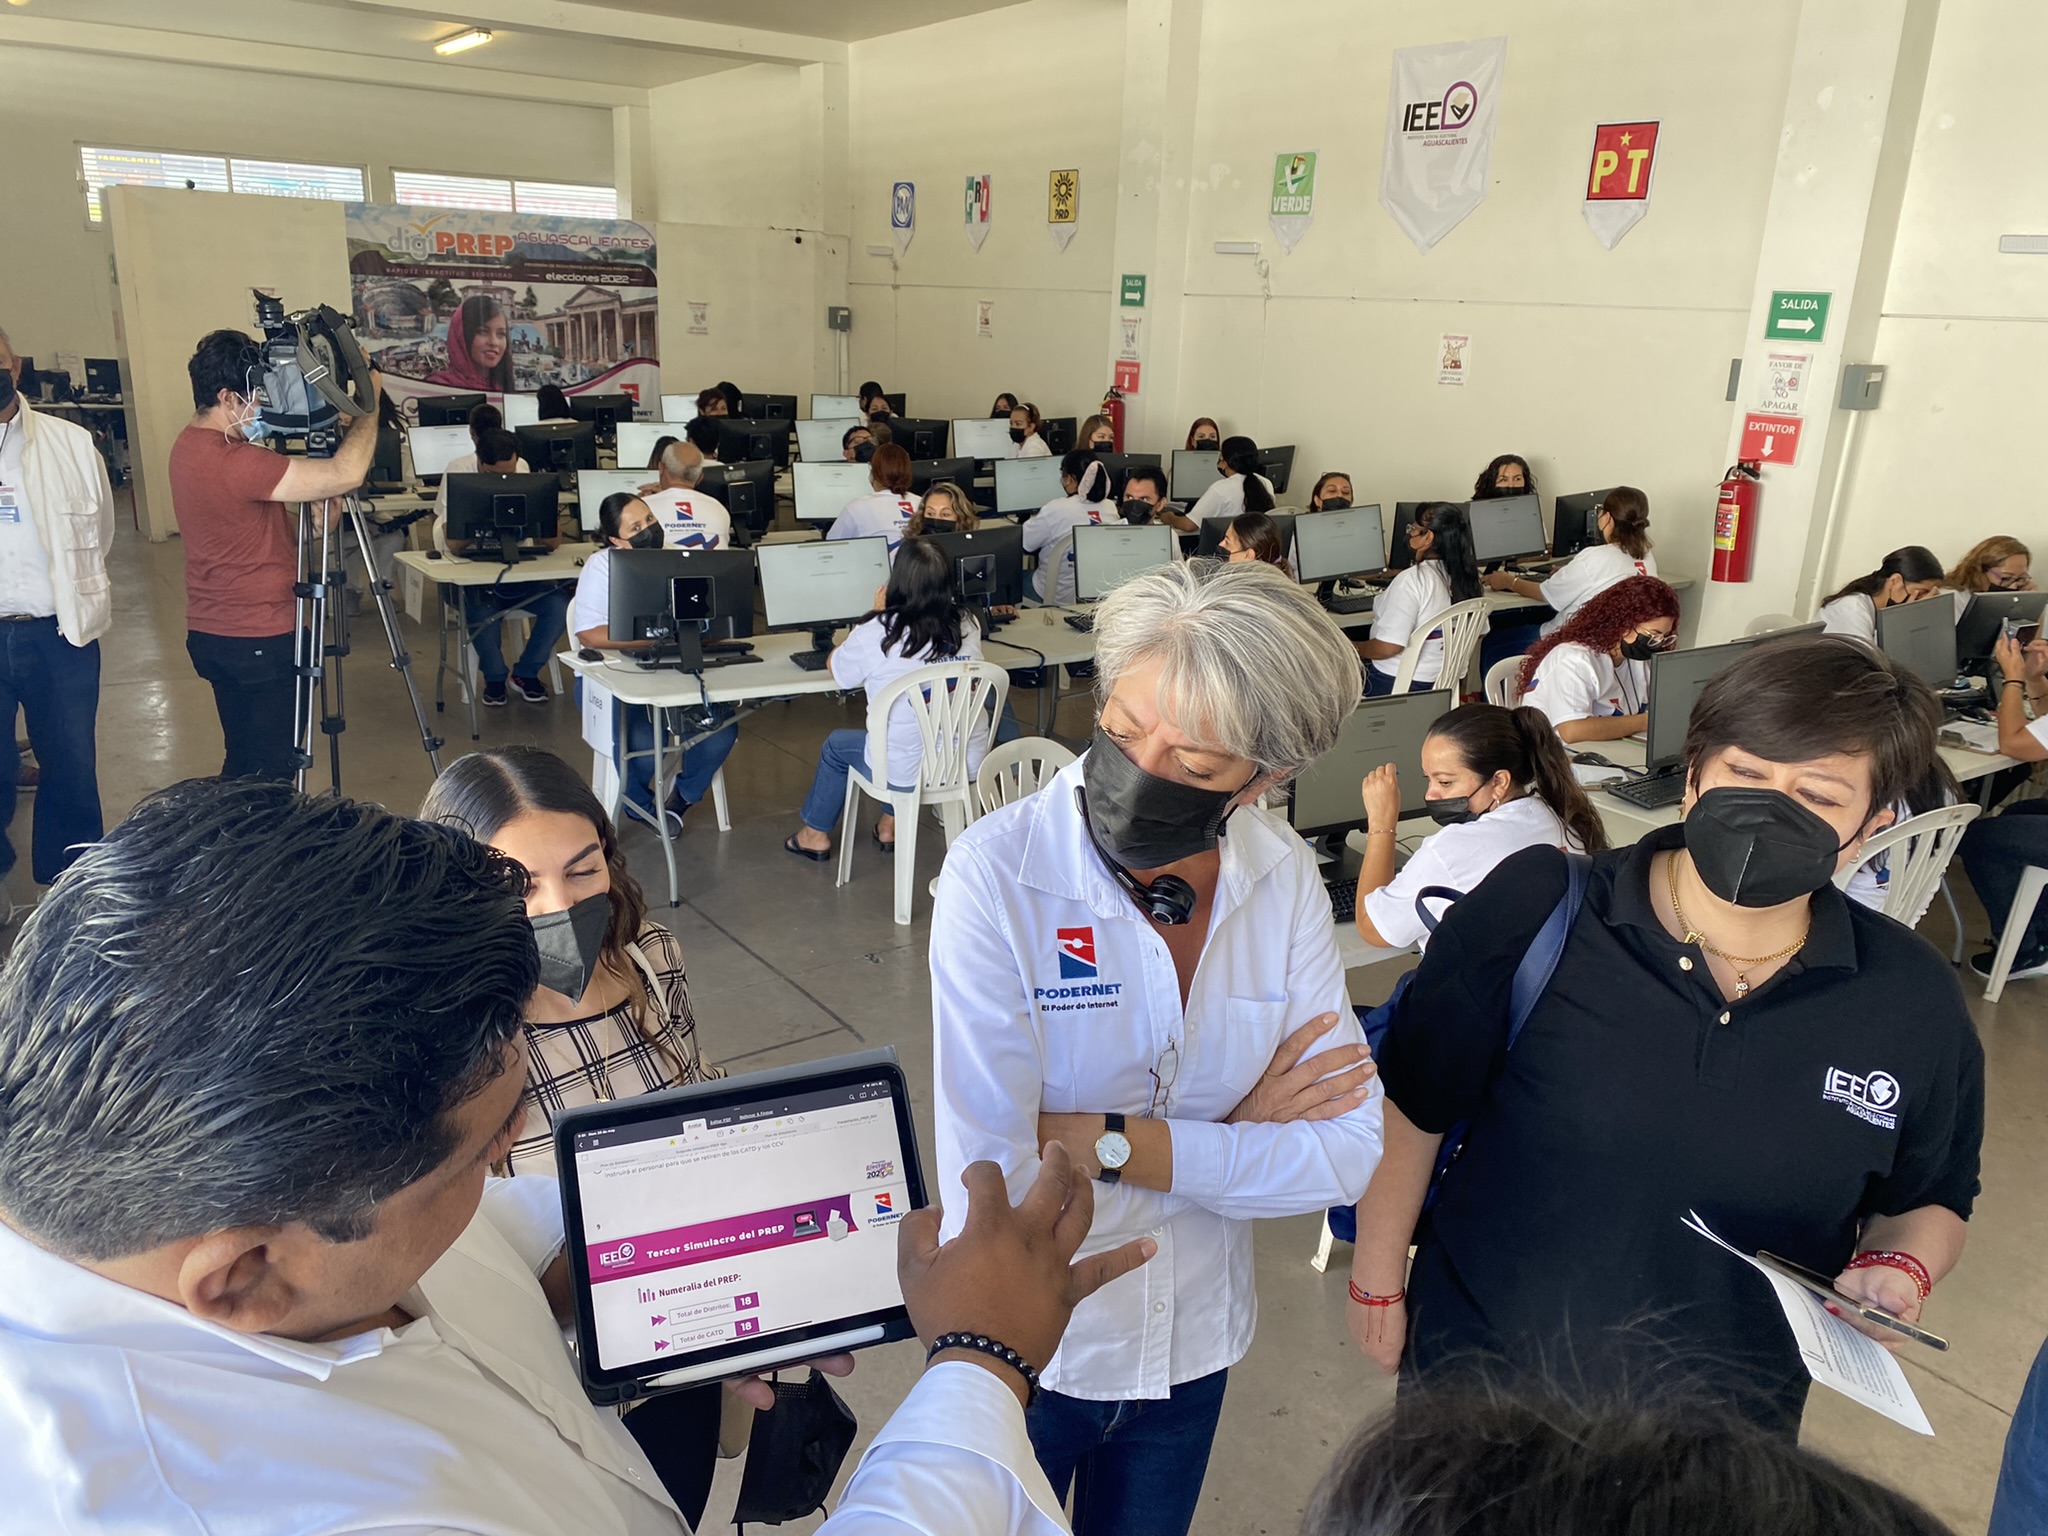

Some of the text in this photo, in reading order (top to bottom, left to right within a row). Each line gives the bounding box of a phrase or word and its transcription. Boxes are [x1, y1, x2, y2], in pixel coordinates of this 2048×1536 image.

[1422, 138, 1468, 147] AGUASCALIENTES
[966, 181, 987, 212] PRI
[1273, 195, 1311, 212] VERDE
[1055, 208, 1070, 219] PRD
[518, 232, 650, 248] AGUASCALIENTES
[545, 272, 630, 284] elecciones 2022
[1780, 298, 1818, 310] SALIDA
[1774, 390, 1788, 398] NO
[1761, 400, 1798, 411] APAGAR
[1748, 421, 1796, 434] EXTINTOR
[1034, 984, 1122, 999] PODERNET
[1087, 1000, 1118, 1009] Internet
[604, 1168, 630, 1179] instruirá
[638, 1162, 664, 1174] personal
[665, 1160, 679, 1168] para
[700, 1151, 721, 1160] retiren
[740, 1146, 756, 1154] CATD
[868, 1212, 903, 1223] PODERNET
[646, 1224, 785, 1259] Tercer Simulacro del PREP
[658, 1273, 742, 1297] Numeralia del PREP:
[677, 1296, 752, 1319] Total de Distritos: 18
[680, 1322, 752, 1344] Total de CATD 18
